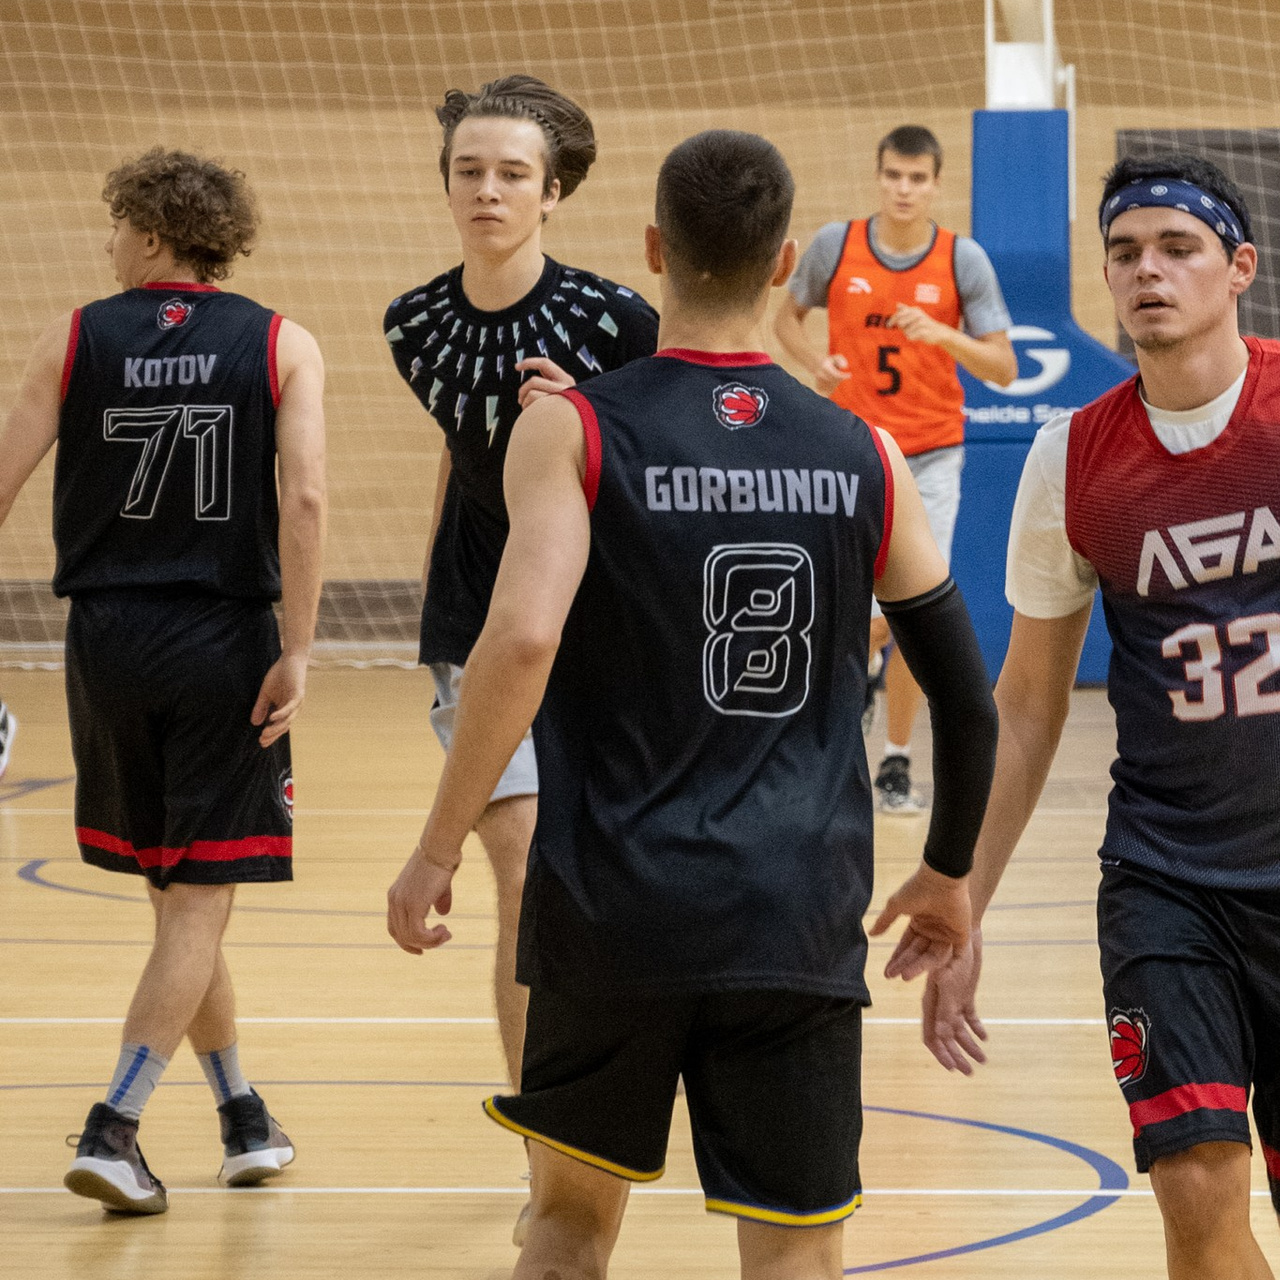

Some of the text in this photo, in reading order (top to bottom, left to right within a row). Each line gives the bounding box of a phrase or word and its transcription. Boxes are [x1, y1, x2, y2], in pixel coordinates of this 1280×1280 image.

[124, 354, 217, 388] KOTOV
[877, 345, 902, 396] 5
[104, 404, 233, 521] 71
[645, 466, 860, 518] GORBUNOV
[703, 542, 815, 718] 8
